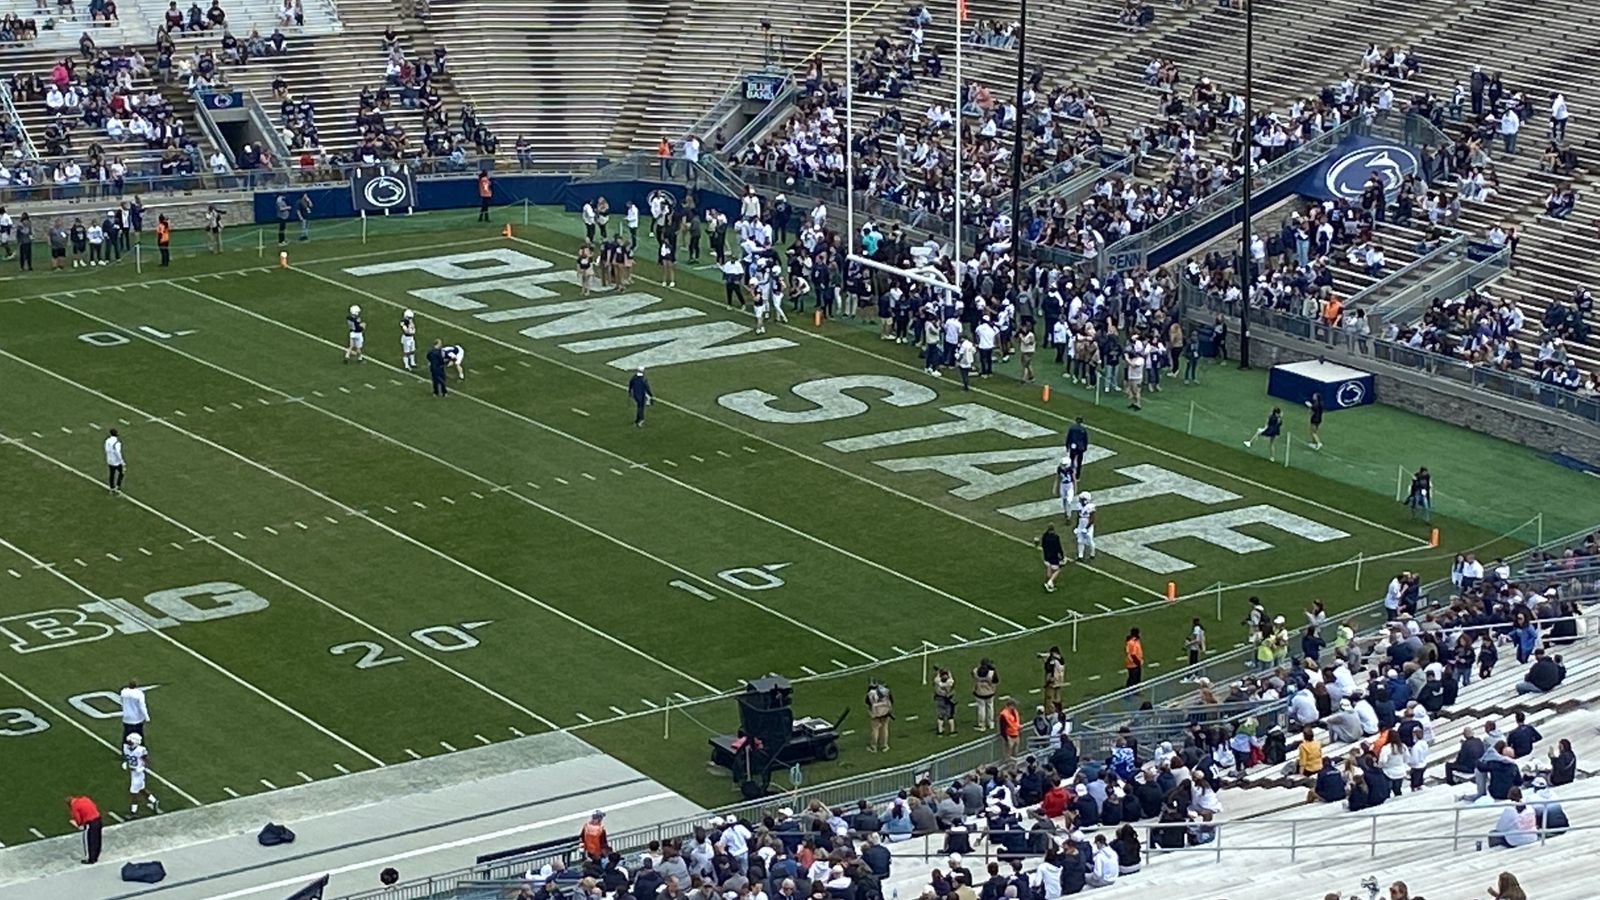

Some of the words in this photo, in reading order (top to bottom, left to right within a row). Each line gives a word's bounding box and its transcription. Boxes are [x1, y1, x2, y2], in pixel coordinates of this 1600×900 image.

[341, 248, 798, 372] PENN
[717, 373, 1351, 574] STATE
[669, 567, 785, 601] 10
[330, 625, 480, 669] 20
[0, 691, 123, 736] 30
